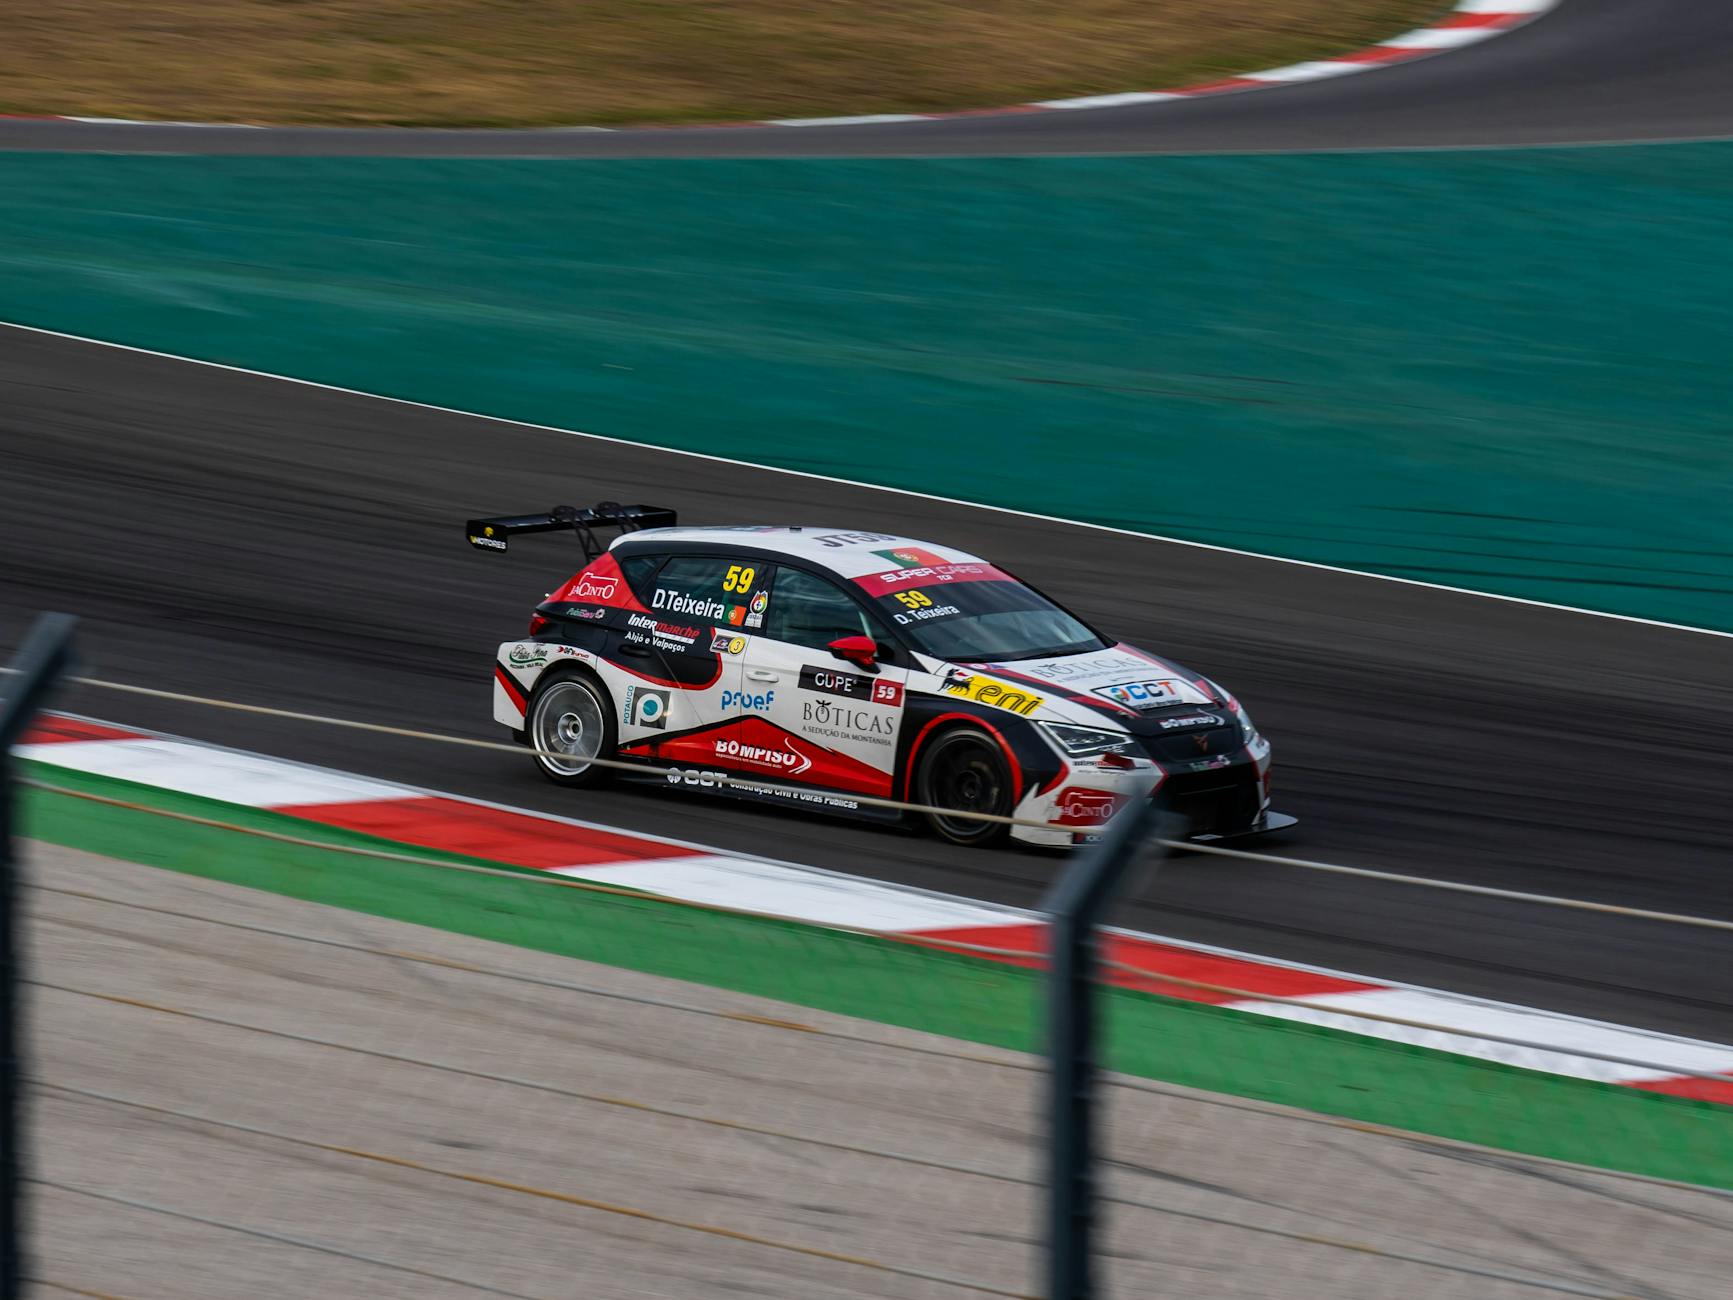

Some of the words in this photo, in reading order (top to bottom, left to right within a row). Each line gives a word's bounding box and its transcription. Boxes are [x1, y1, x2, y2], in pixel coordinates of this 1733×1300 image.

[723, 565, 755, 594] 59
[880, 567, 936, 583] SUPER
[936, 565, 984, 576] CARS
[568, 582, 615, 600] JACINTO
[894, 590, 933, 609] 59
[651, 588, 725, 620] D.Teixeira
[893, 613, 913, 625] D.
[907, 605, 961, 621] Teixeira
[652, 636, 686, 653] Valpaços
[721, 690, 774, 711] proef
[876, 685, 896, 700] 59
[975, 685, 1043, 715] eni
[803, 701, 894, 735] BOTICAS
[807, 726, 840, 738] SEDUÇÃO
[840, 732, 850, 740] DA
[851, 734, 892, 747] MONTANHA
[715, 740, 796, 766] BOMPISO
